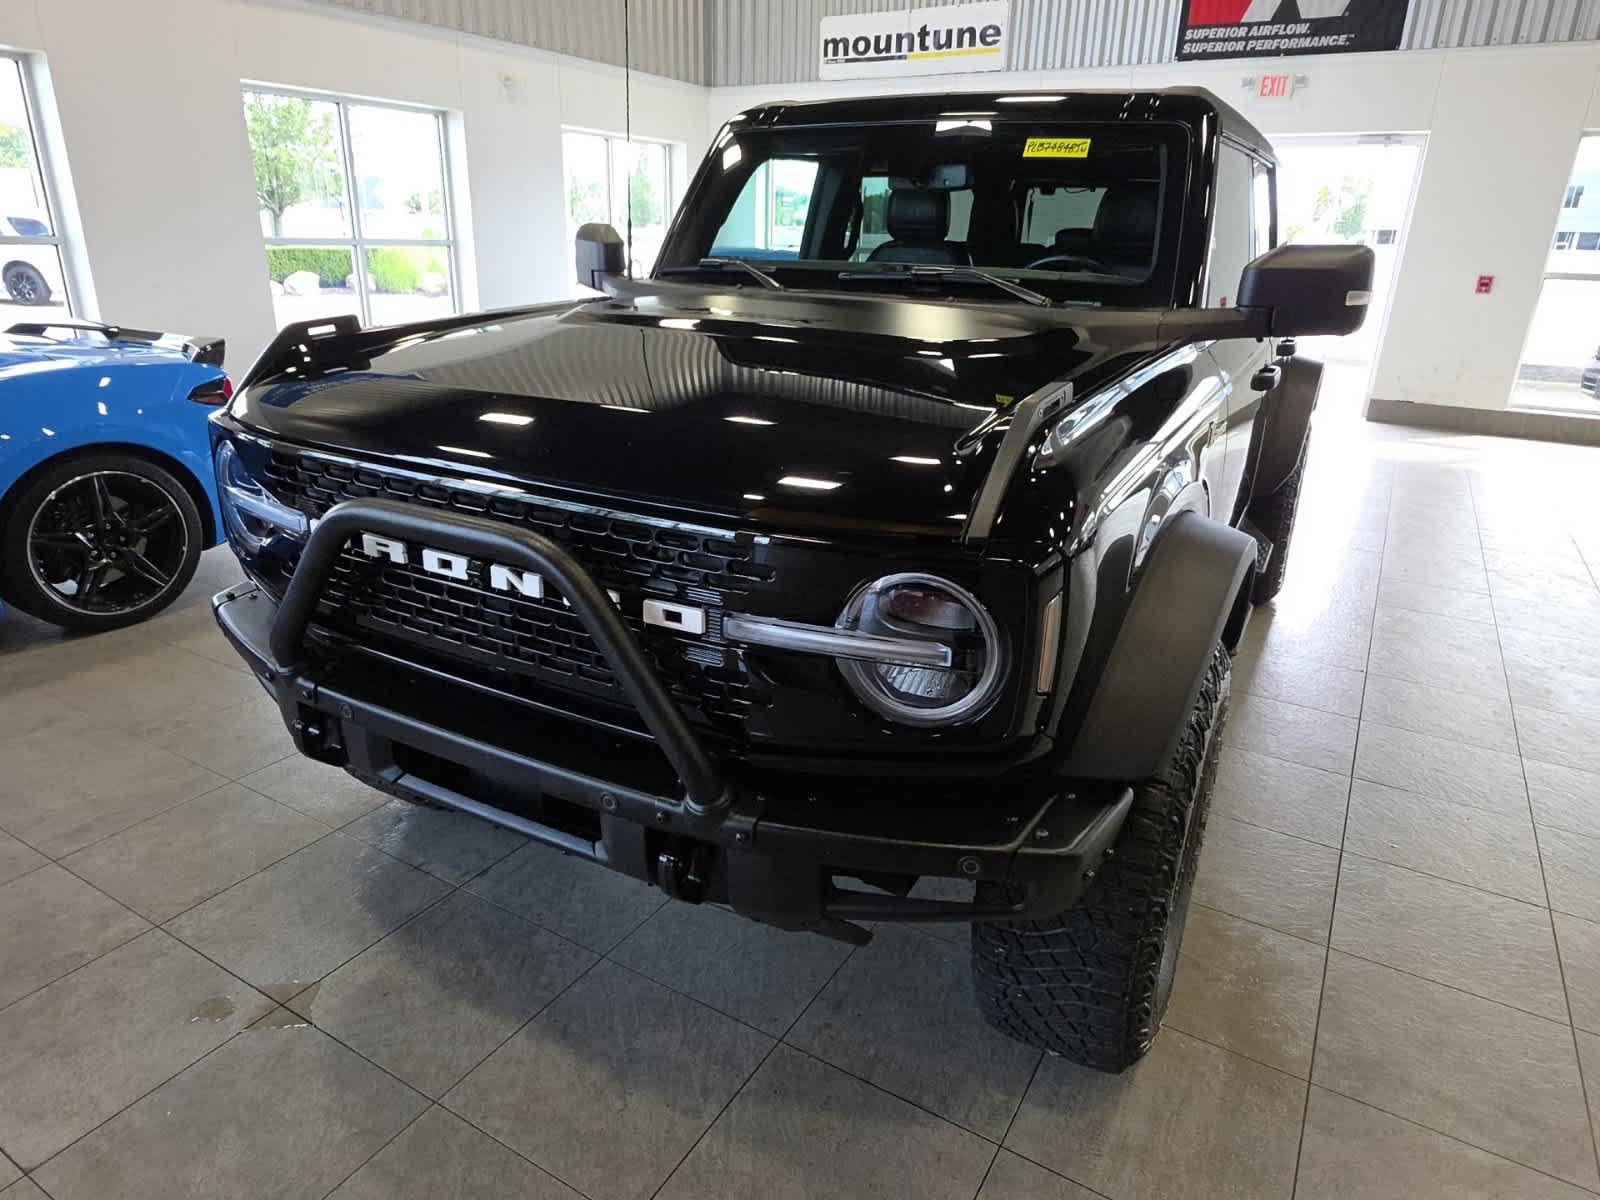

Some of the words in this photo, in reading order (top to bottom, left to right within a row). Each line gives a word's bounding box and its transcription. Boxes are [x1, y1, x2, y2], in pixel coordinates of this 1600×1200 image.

[823, 24, 1002, 57] mountune
[1185, 26, 1249, 40] SUPERIOR
[1249, 22, 1311, 37] AIRFLOW.
[1183, 40, 1249, 54] SUPERIOR
[1260, 75, 1288, 97] EXIT
[344, 533, 706, 634] RONO
